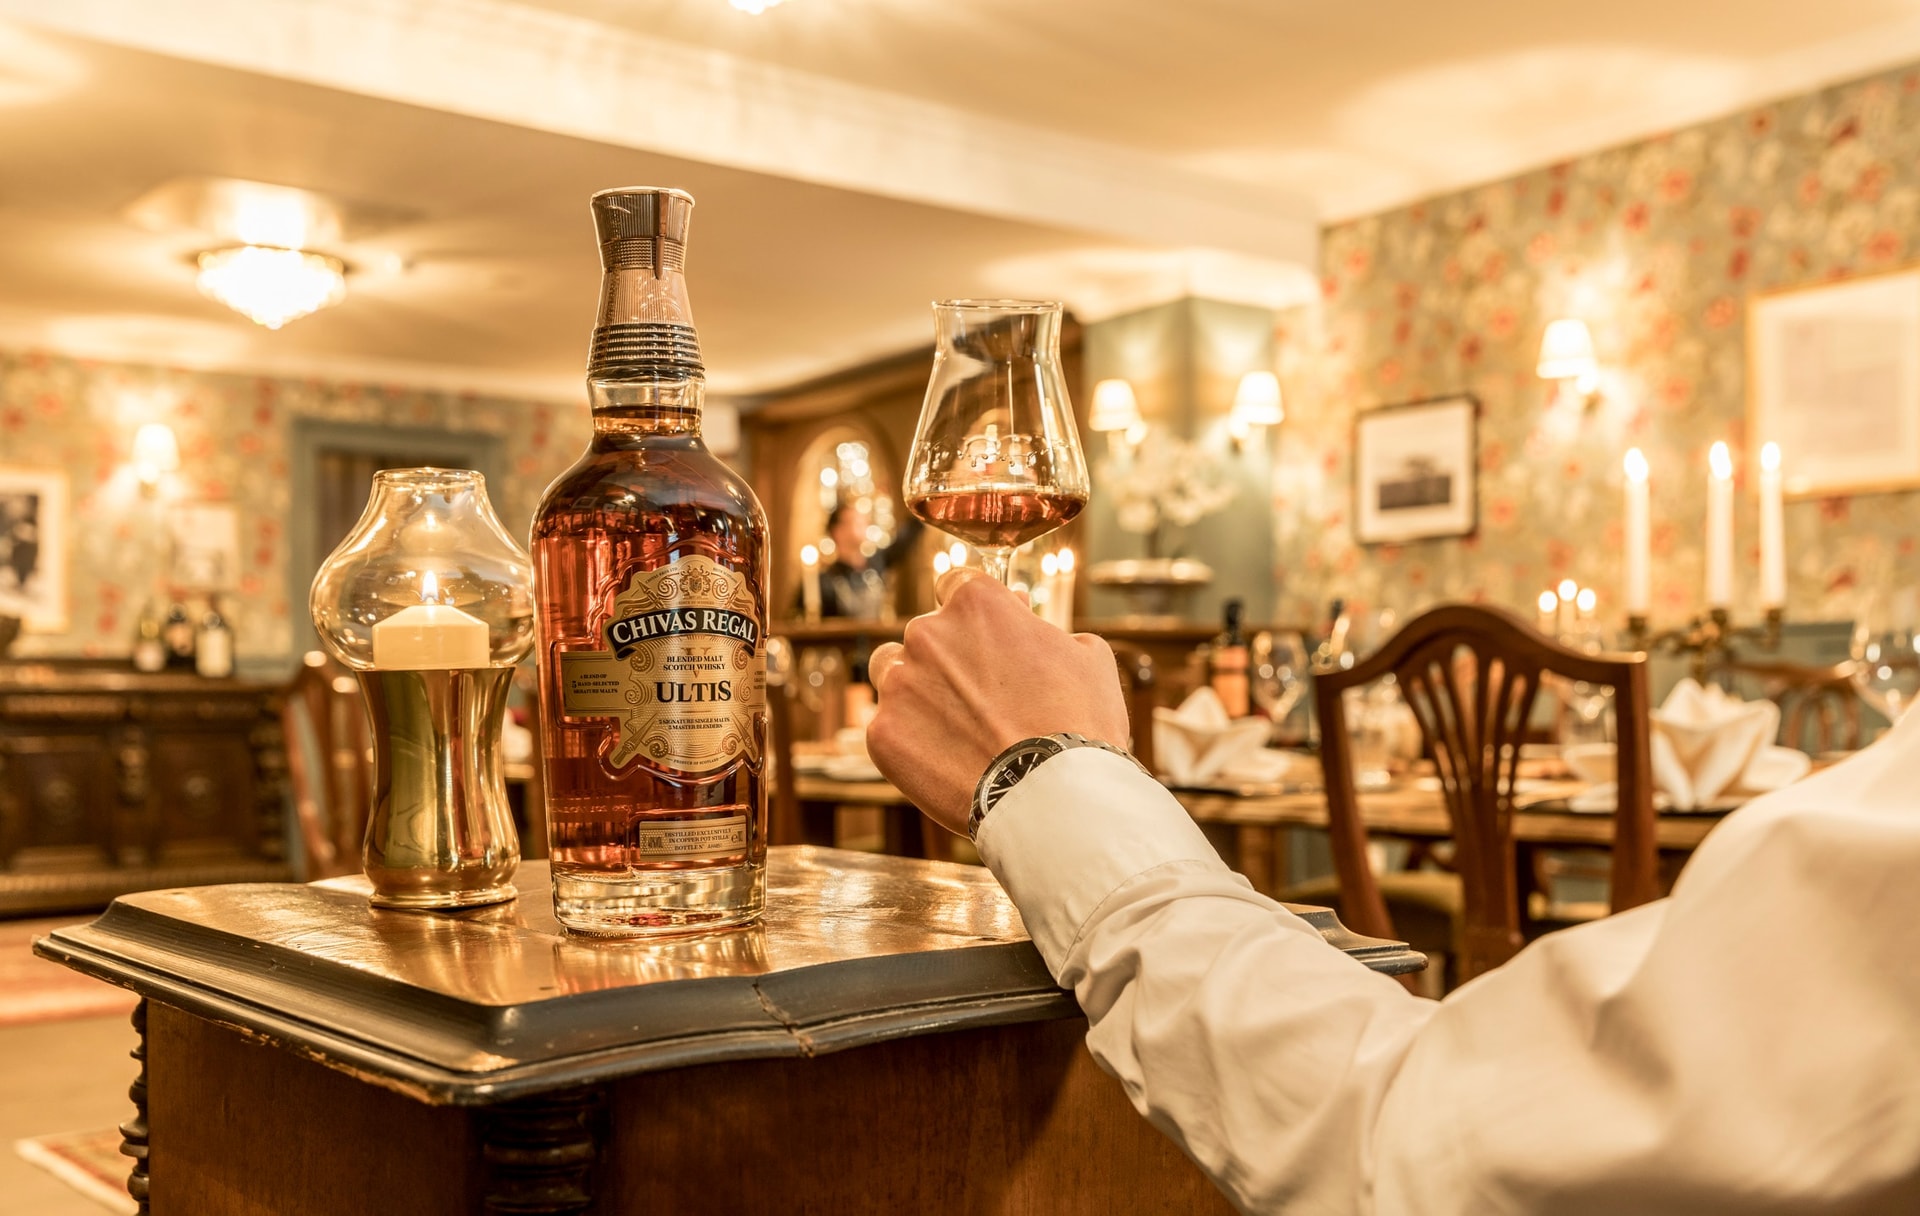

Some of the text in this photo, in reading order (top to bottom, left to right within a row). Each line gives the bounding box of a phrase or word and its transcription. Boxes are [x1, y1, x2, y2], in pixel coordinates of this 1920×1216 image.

[613, 610, 756, 643] CHIVAS REGAL
[666, 655, 703, 663] BLENDED
[696, 663, 725, 671] WHISKY
[571, 680, 577, 689] 5
[654, 680, 732, 703] ULTIS
[697, 828, 732, 836] EXCLUSIVELY
